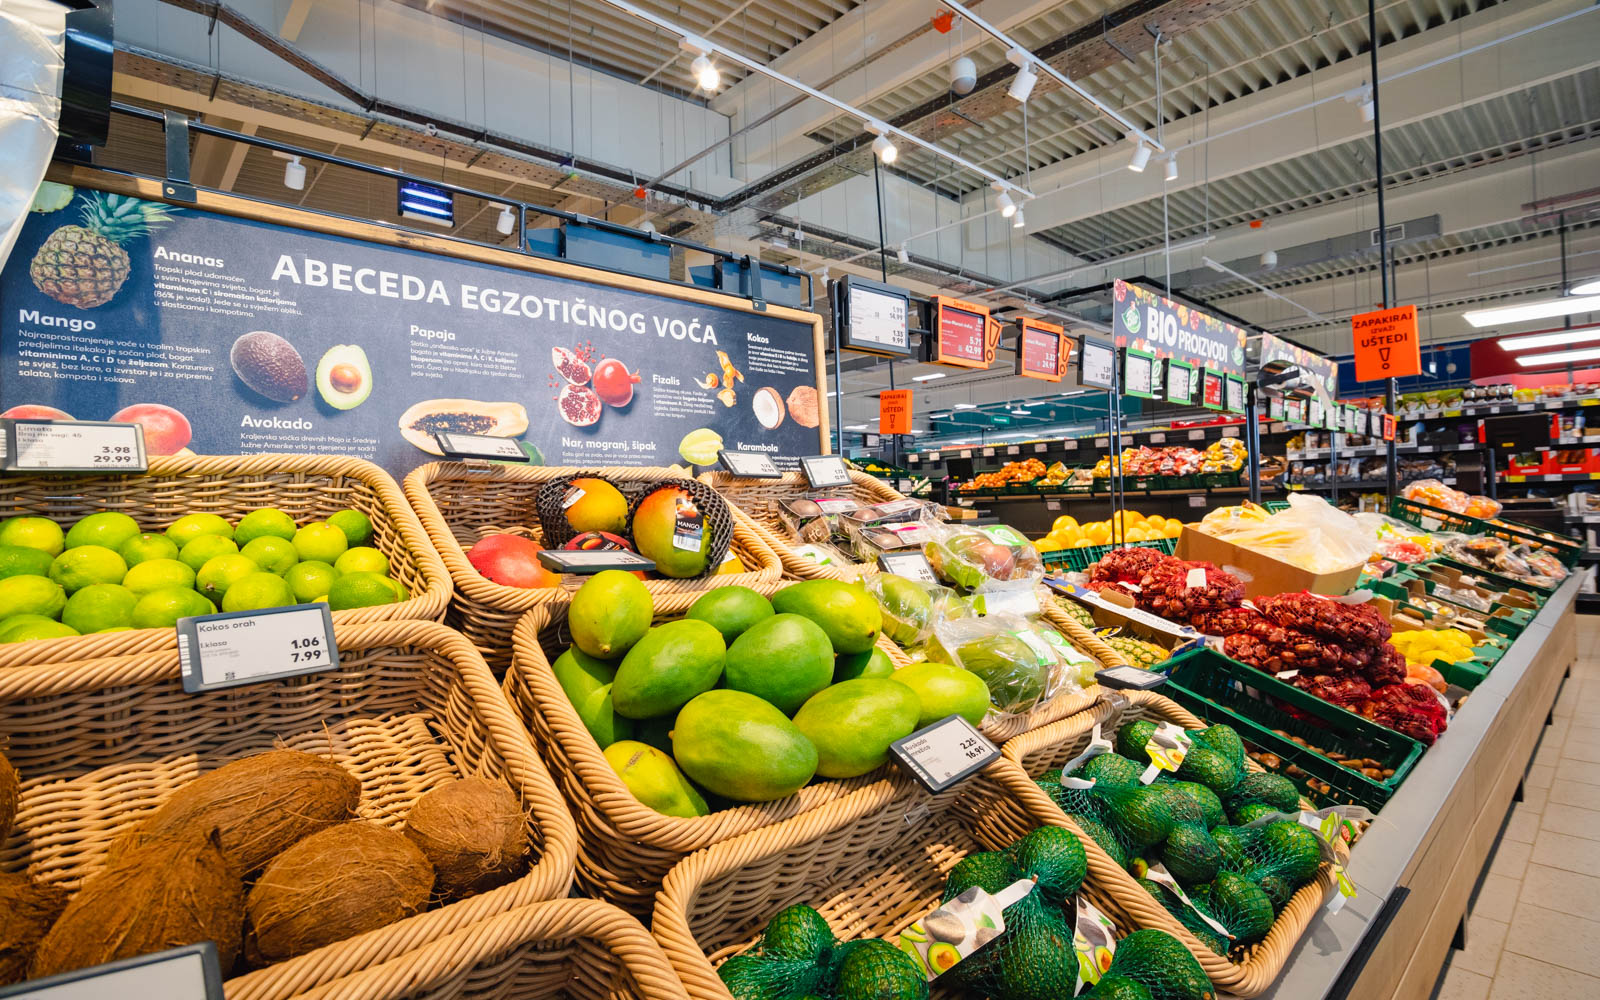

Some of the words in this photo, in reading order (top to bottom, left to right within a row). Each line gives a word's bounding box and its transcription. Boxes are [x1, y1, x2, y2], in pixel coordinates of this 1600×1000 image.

[154, 246, 224, 268] Ananas
[154, 264, 182, 275] Tropski
[185, 269, 202, 277] plod
[204, 272, 245, 282] udomaćen
[161, 274, 180, 282] svim
[182, 276, 220, 288] krajevima
[222, 282, 248, 292] svijeta,
[250, 286, 271, 296] bogat
[154, 282, 200, 294] vitaminom
[214, 289, 254, 300] siromašan
[256, 295, 296, 306] kalorijama
[154, 290, 174, 299] (86%
[176, 292, 184, 300] je
[214, 297, 231, 306] Jede
[250, 302, 279, 313] svježem
[271, 254, 450, 307] ABECEDA
[461, 283, 646, 335] EGZOTIČNOG
[653, 315, 718, 346] VOĆA
[162, 300, 204, 312] slasticama
[210, 306, 256, 318] kompotima.
[20, 309, 96, 332] Mango
[1354, 312, 1412, 328] ZAPAKIRAJ
[410, 325, 456, 342] Papaja
[747, 332, 770, 344] Kokos
[1147, 306, 1177, 346] BIO
[1178, 330, 1228, 363] PROIZVODI
[1361, 332, 1408, 348] UŠTEDI
[18, 330, 114, 346] Najrasprostranjenije
[116, 339, 137, 348] voće
[148, 342, 174, 352] toplim
[176, 345, 211, 356] tropskim
[18, 339, 70, 352] predjelima
[73, 345, 106, 354] itekako
[108, 348, 117, 356] je
[118, 348, 144, 358] sočan
[146, 350, 168, 360] plod,
[169, 352, 194, 364] bogat
[18, 350, 77, 360] vitaminima
[80, 354, 90, 363] A,
[128, 358, 170, 368] željezom.
[172, 363, 214, 372] Konzumira
[18, 368, 52, 378] salata,
[54, 372, 97, 382] kompota
[104, 375, 136, 384] sokova.
[32, 360, 60, 370] svjež,
[61, 362, 78, 370] bez
[80, 364, 103, 374] kore,
[114, 366, 148, 376] izvrstan
[150, 369, 158, 378] je
[176, 372, 212, 382] pripremu
[652, 374, 680, 386] Fizalis
[241, 415, 312, 430] Avokado
[240, 432, 278, 441] Kraljevska
[562, 437, 584, 448] Nar,
[586, 440, 630, 452] mogranj,
[632, 440, 656, 452] šipak
[738, 442, 778, 452] Karambola
[677, 520, 700, 530] MANGO
[199, 624, 230, 632] Kokos
[232, 620, 256, 628] orah
[291, 636, 320, 649] 1.06
[291, 650, 321, 662] 7.99
[966, 746, 986, 759] 16.99
